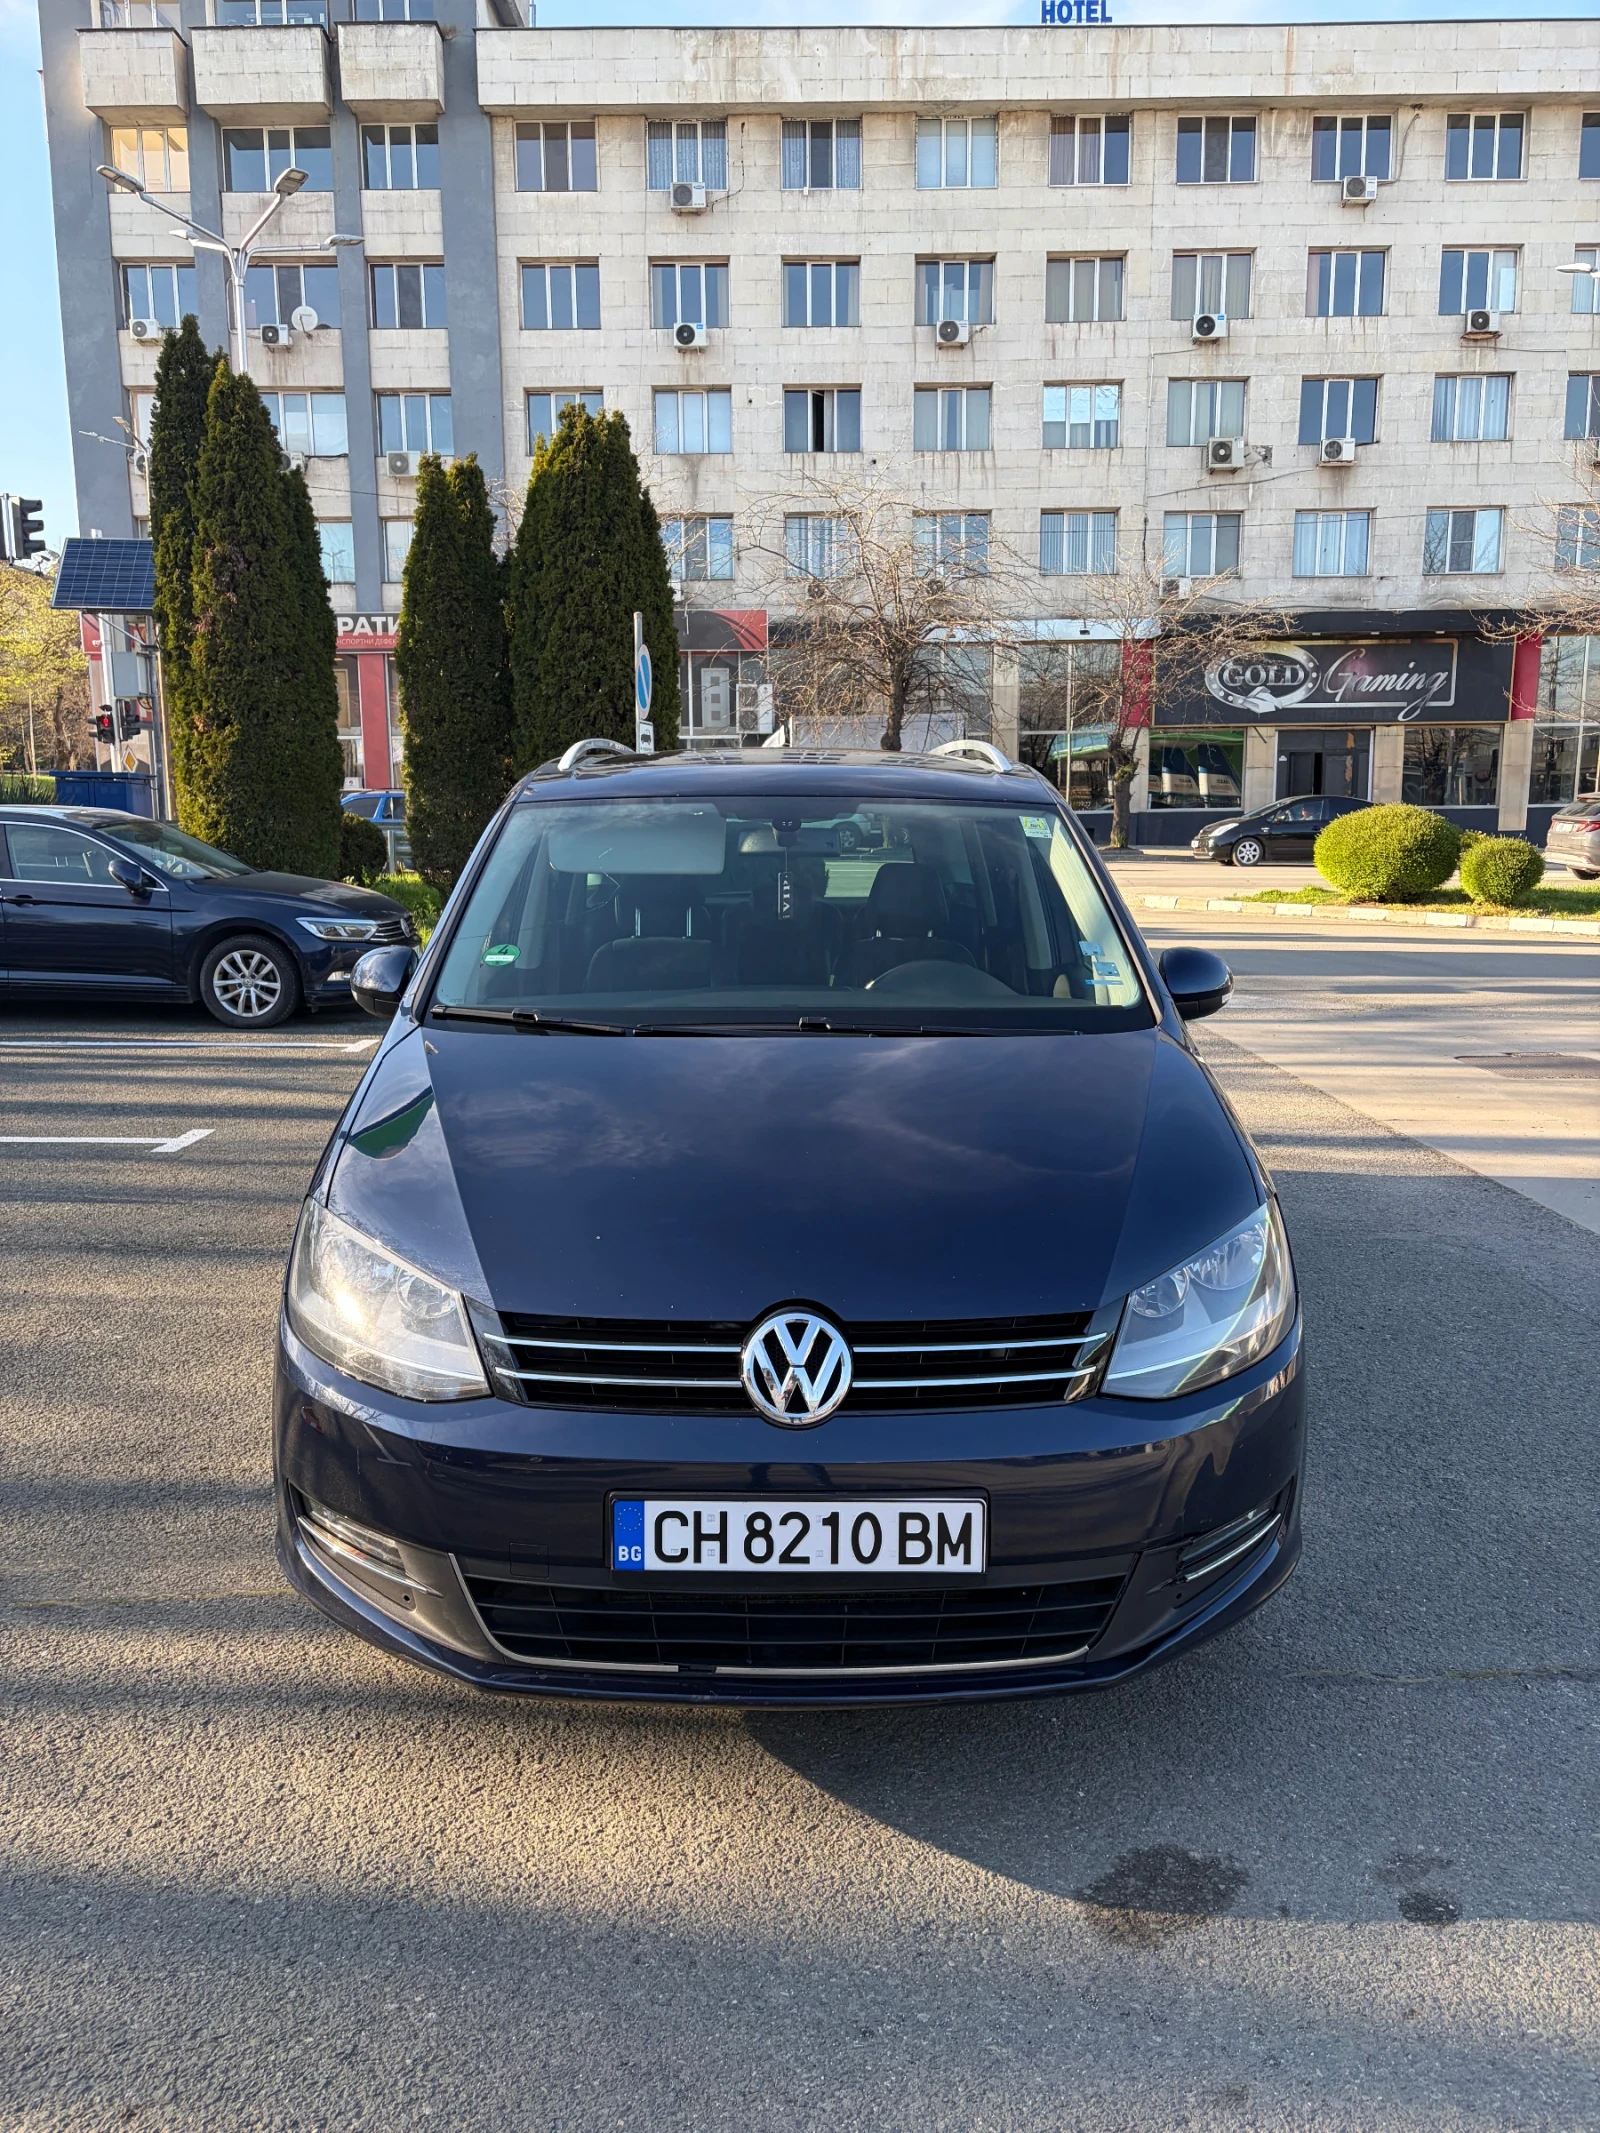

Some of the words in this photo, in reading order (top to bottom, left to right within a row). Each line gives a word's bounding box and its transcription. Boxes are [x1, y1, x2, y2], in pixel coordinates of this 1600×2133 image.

[1041, 0, 1113, 24] HOTEL
[1222, 664, 1305, 687] GOLD
[1322, 648, 1449, 721] Gaming
[498, 944, 509, 956] 4
[654, 1510, 728, 1564] CH
[743, 1511, 883, 1565] 8210
[898, 1511, 972, 1566] BM
[618, 1545, 642, 1562] BG
